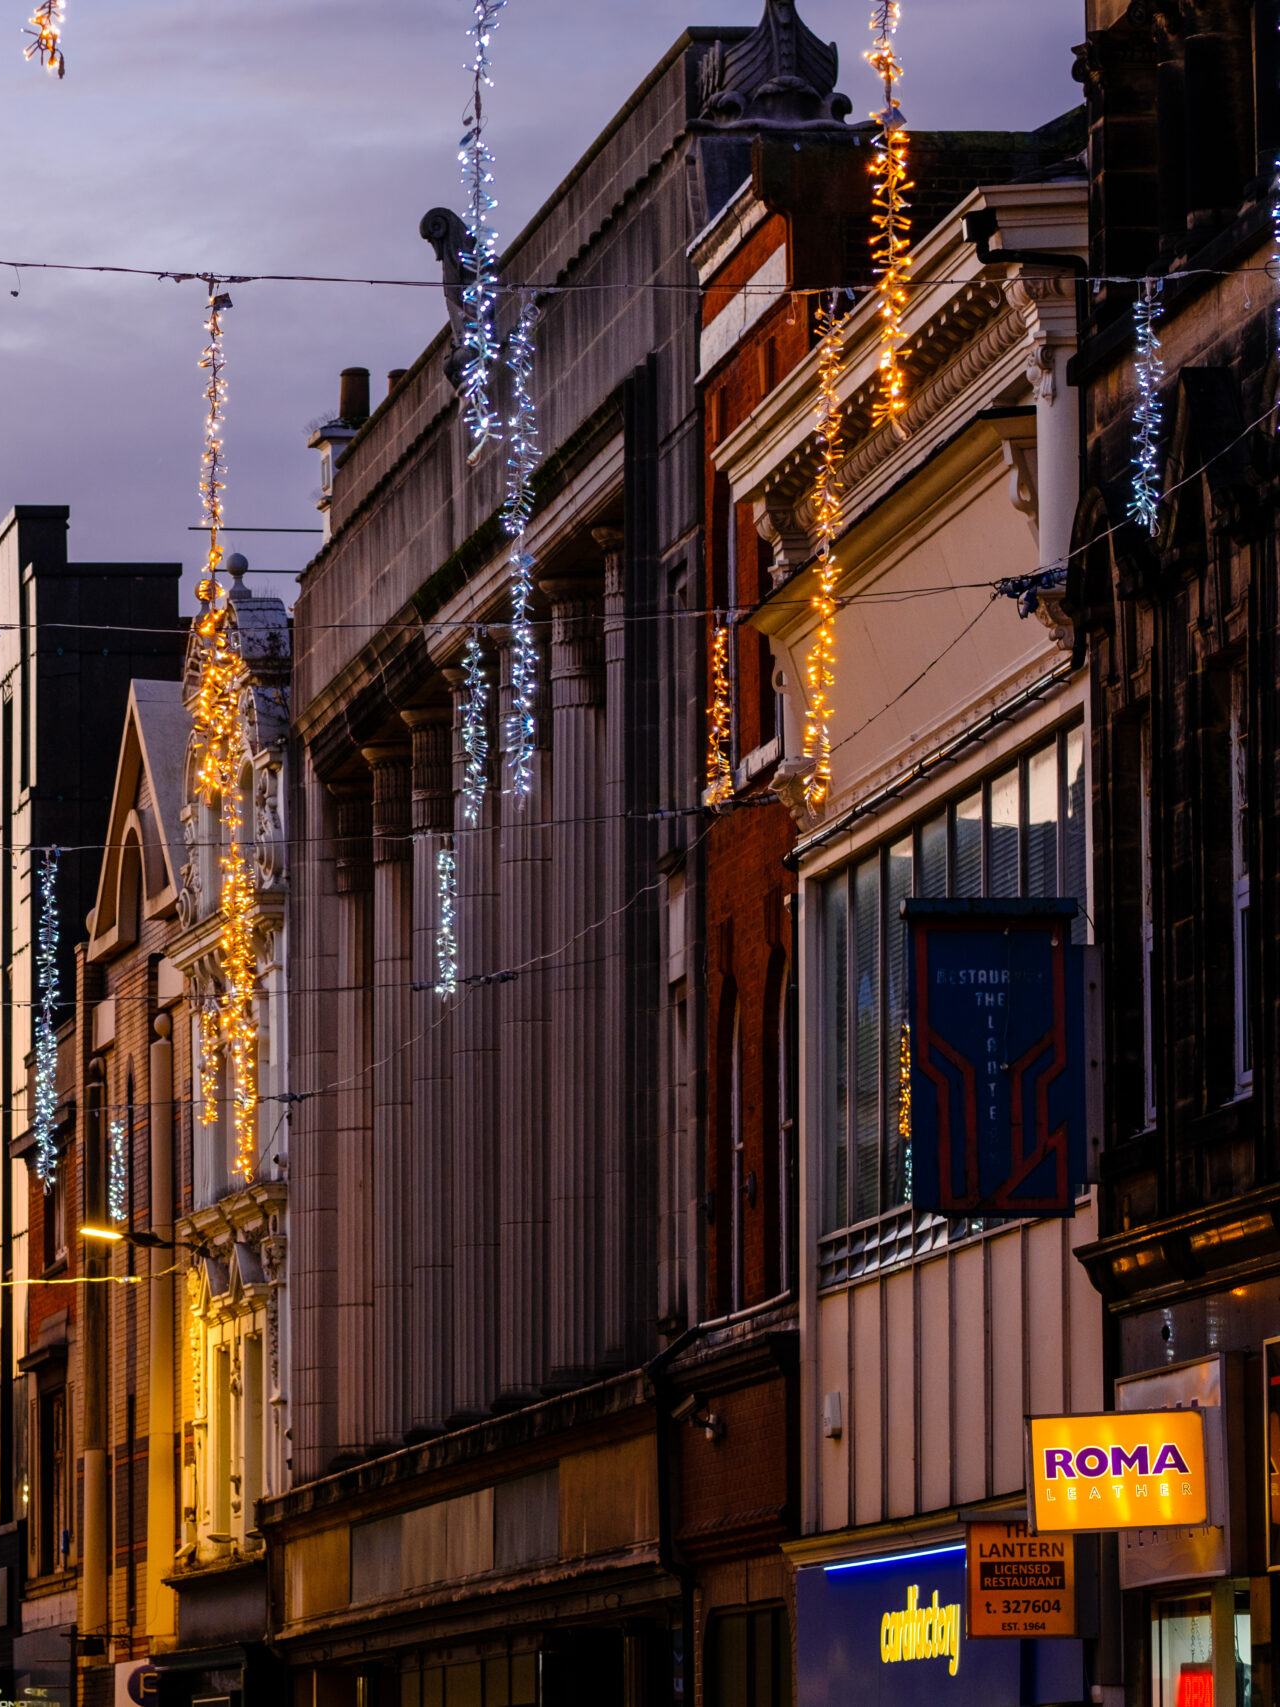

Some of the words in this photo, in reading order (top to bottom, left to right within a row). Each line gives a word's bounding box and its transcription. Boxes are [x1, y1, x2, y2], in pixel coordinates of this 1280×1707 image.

[975, 992, 1005, 1007] THE
[1043, 1442, 1193, 1480] ROMA
[1046, 1483, 1193, 1501] LEATHER
[980, 1542, 1064, 1558] LANTERN
[994, 1564, 1051, 1575] LICENSED
[984, 1576, 1062, 1588] RESTAURANT
[985, 1601, 997, 1614] t.
[1002, 1600, 1061, 1614] 327604
[881, 1584, 960, 1676] cardfactory
[1001, 1622, 1020, 1631] EST.
[1023, 1622, 1046, 1631] 1964
